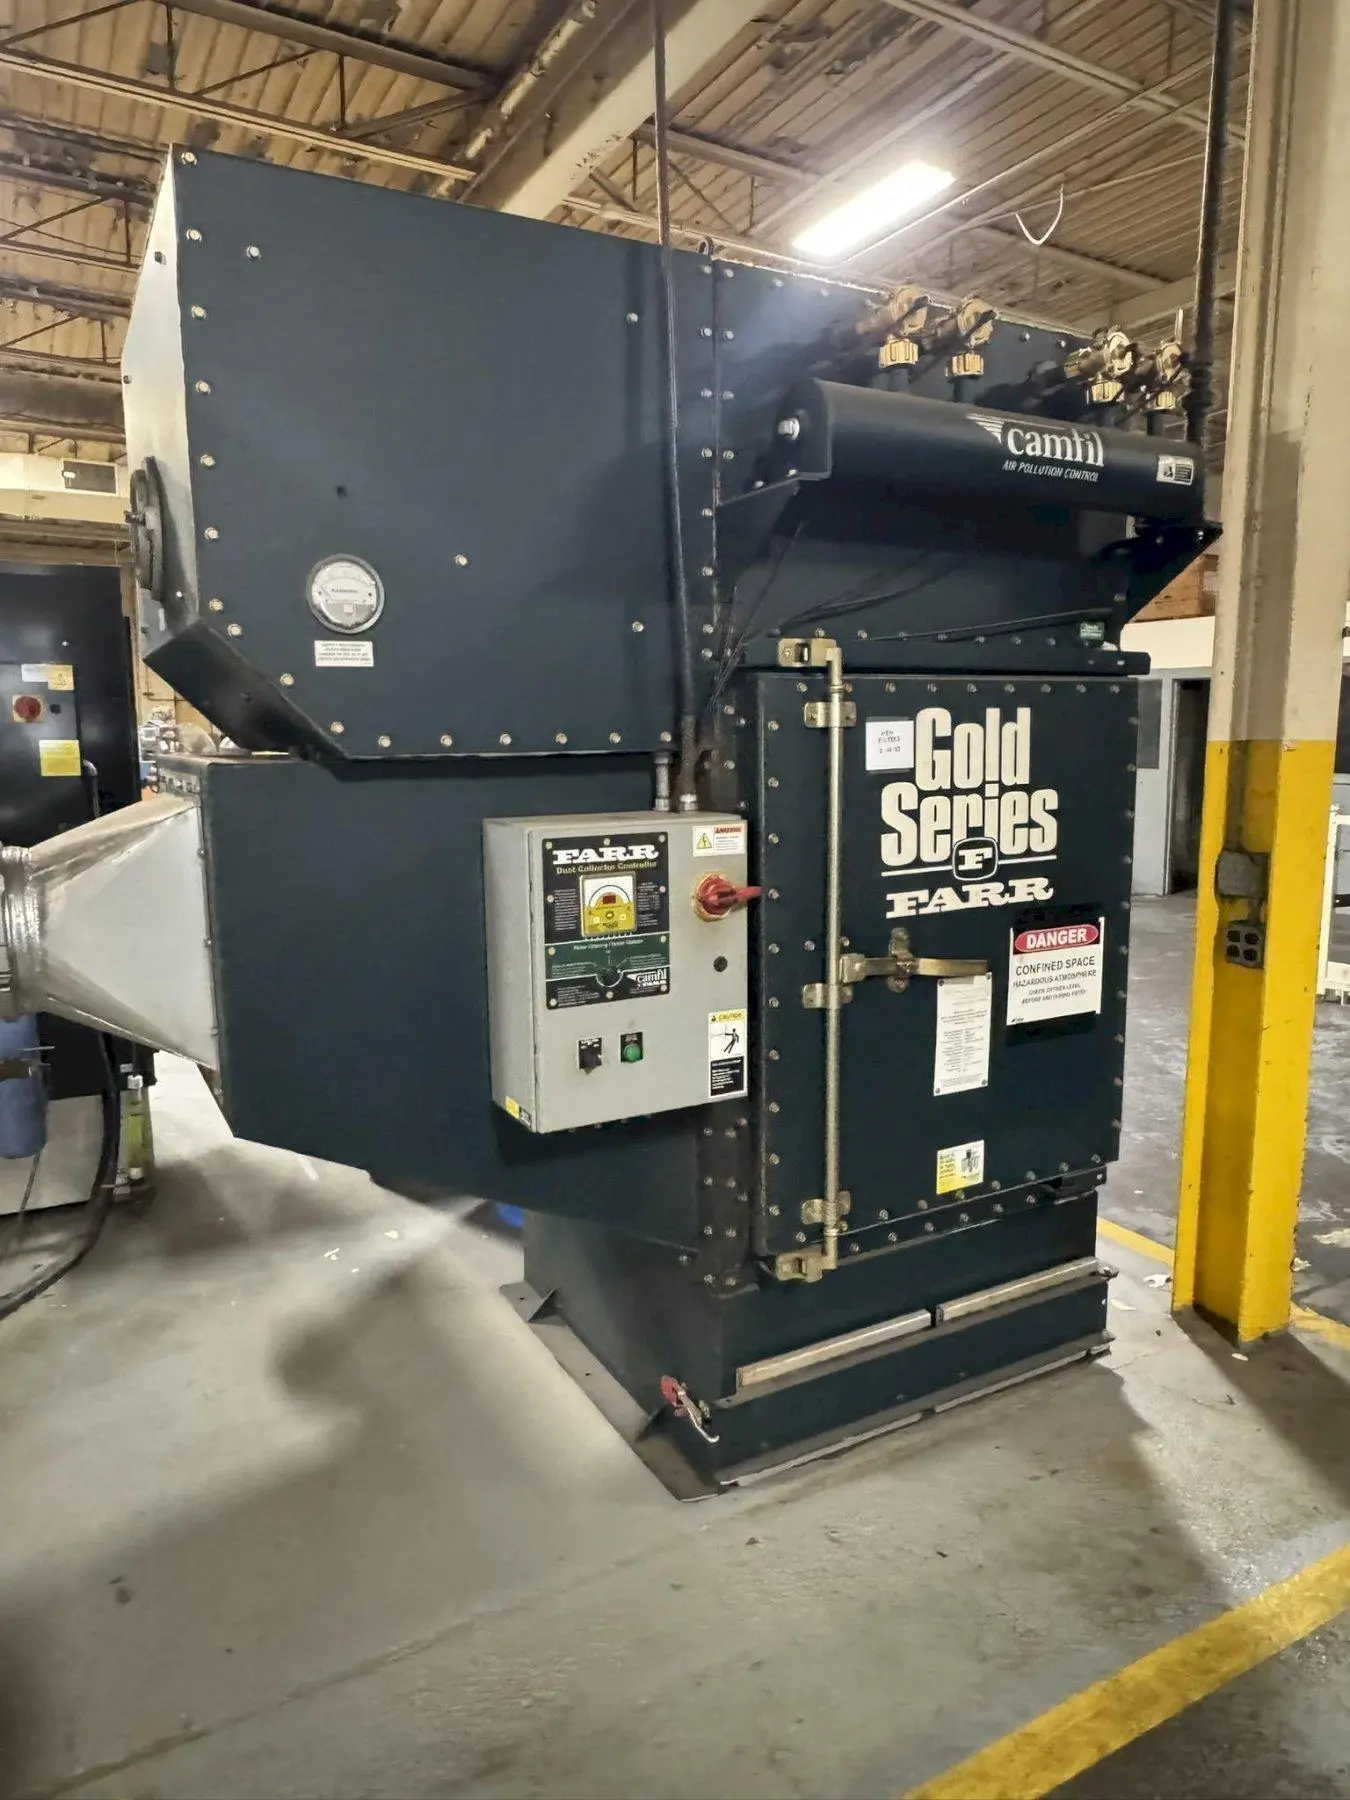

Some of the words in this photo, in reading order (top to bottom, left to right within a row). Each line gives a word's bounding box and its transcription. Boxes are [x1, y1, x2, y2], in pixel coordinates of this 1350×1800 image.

[1007, 427, 1104, 467] camfil
[1002, 460, 1016, 471] AIR
[1018, 462, 1063, 477] POLLUTION
[1064, 468, 1099, 482] CONTROL
[915, 707, 1031, 791] Gold
[881, 781, 1059, 866] Series
[552, 844, 659, 865] FARR
[958, 847, 993, 871] F
[556, 866, 576, 875] Dust
[578, 864, 616, 873] Collector
[618, 861, 657, 870] Controller
[886, 877, 1054, 919] FARR
[1026, 928, 1088, 950] DANGER
[1016, 960, 1063, 976] CONFINED
[1066, 956, 1096, 969] SPACE
[1013, 975, 1054, 988] HAZARDOUS
[1054, 969, 1097, 982] ATMOSPHERE
